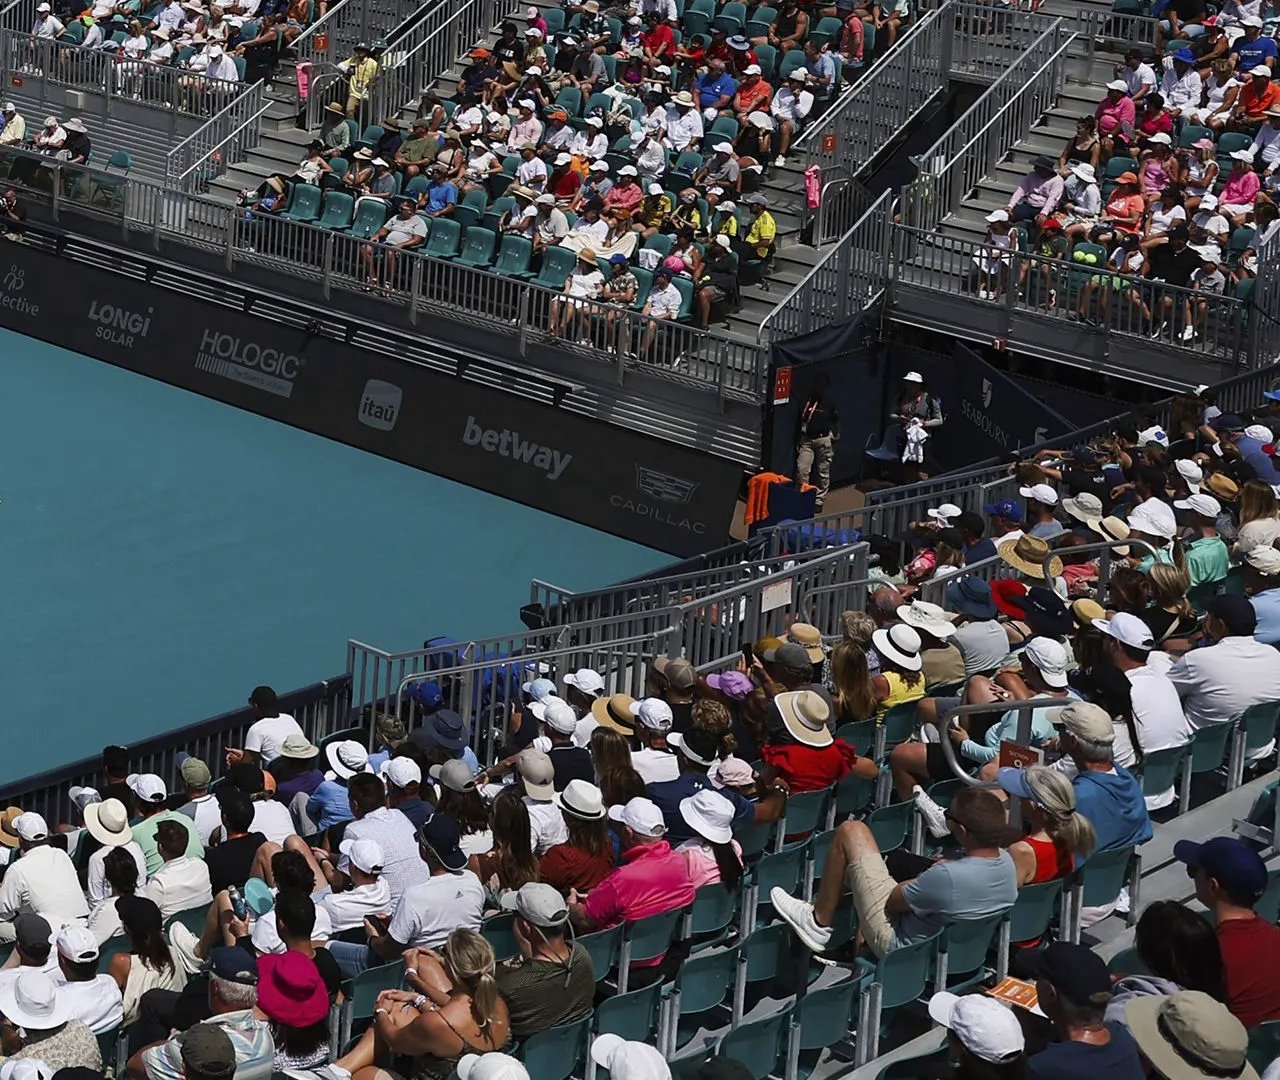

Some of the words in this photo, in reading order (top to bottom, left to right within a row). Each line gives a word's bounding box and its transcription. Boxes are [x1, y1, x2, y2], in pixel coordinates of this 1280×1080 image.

[95, 326, 135, 349] SOLAR
[200, 328, 300, 379] HOLOGIC
[362, 396, 394, 423] itaú
[962, 399, 1009, 448] SEABOURN
[462, 415, 573, 480] betway
[609, 494, 707, 535] CADILLAC
[1008, 750, 1030, 761] SECTION
